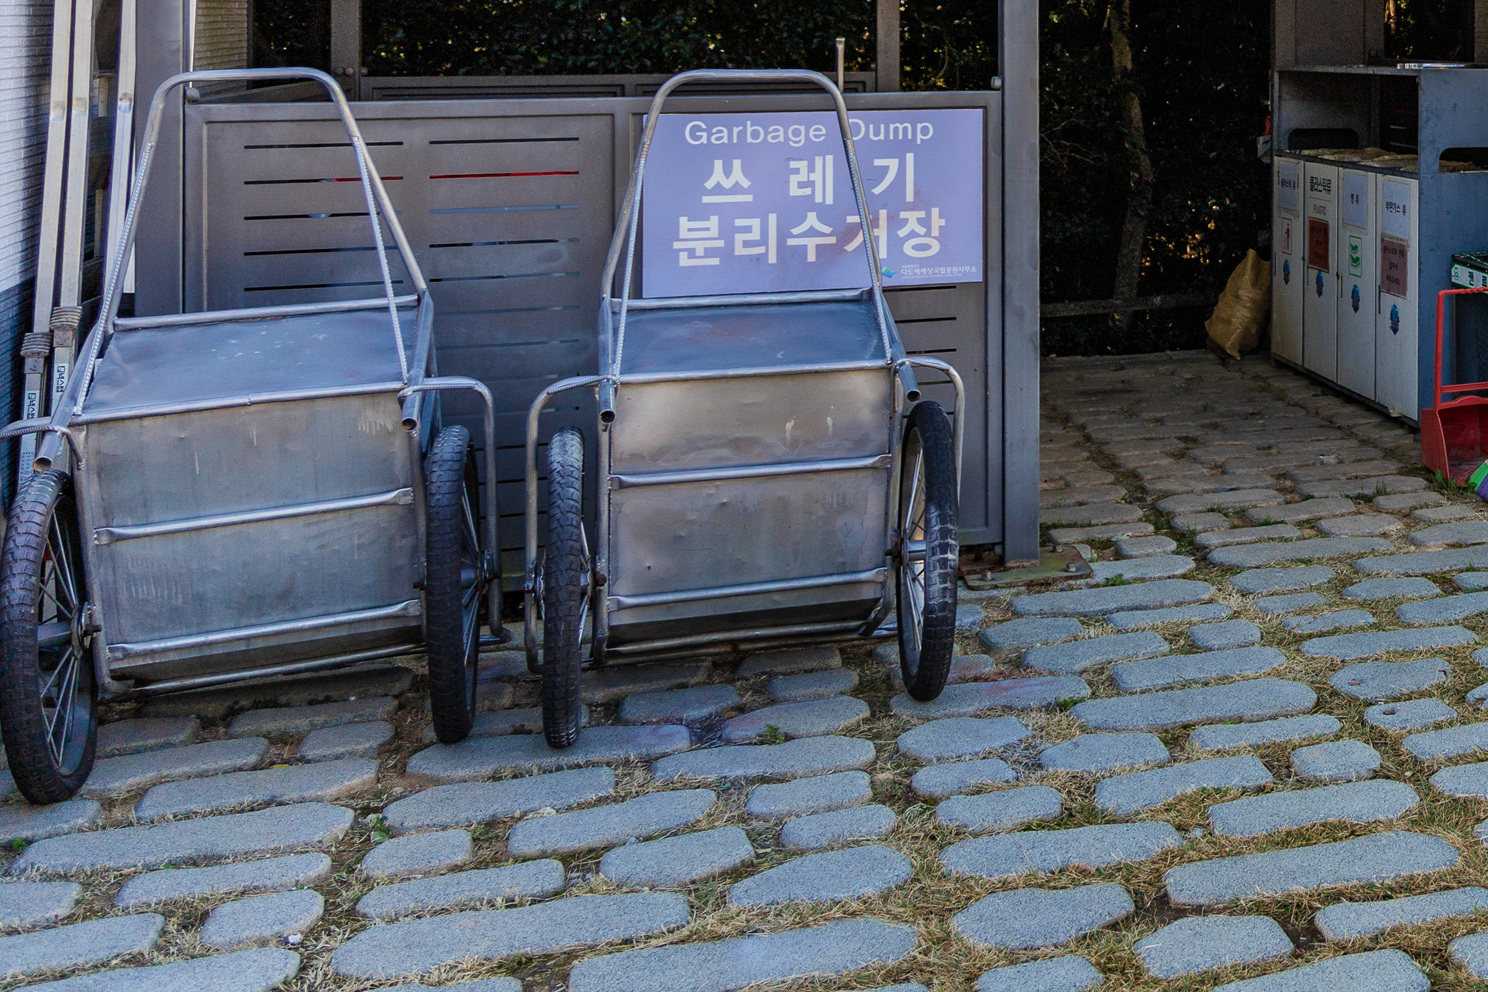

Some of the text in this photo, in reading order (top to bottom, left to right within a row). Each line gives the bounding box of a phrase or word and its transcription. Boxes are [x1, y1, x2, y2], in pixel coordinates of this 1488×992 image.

[684, 117, 935, 147] Garbage Dump
[672, 207, 946, 267] 분리수거장
